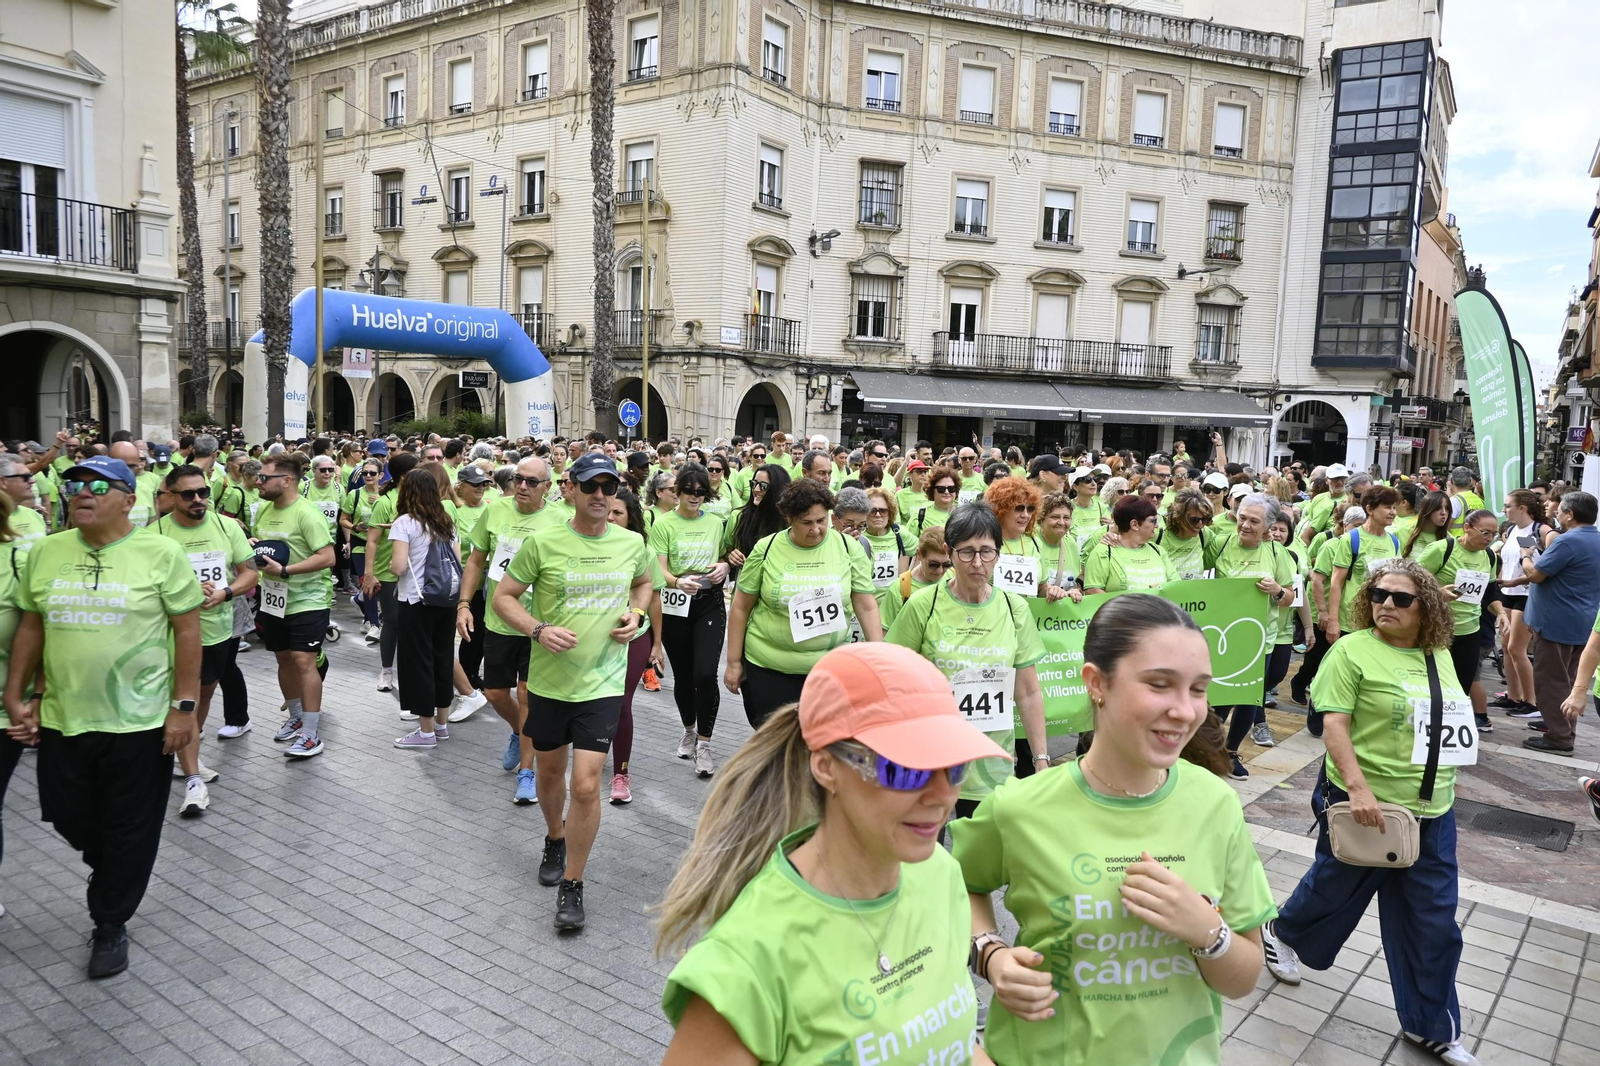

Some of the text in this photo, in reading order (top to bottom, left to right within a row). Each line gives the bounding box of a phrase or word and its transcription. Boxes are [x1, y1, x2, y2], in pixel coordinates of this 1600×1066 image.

[351, 303, 499, 341] Huelva original
[566, 569, 628, 581] En marcha
[53, 578, 71, 589] En
[566, 582, 626, 595] contra el
[48, 592, 127, 609] contra el
[565, 594, 624, 610] cáncer
[47, 605, 127, 626] cáncer
[937, 641, 1008, 657] En marcha
[1065, 666, 1077, 679] el
[952, 691, 1004, 716] 441
[1074, 894, 1113, 920] En
[1073, 953, 1202, 988] cánce
[1083, 987, 1169, 1003] MARCHA EN HUELVA
[855, 1031, 900, 1066] En
